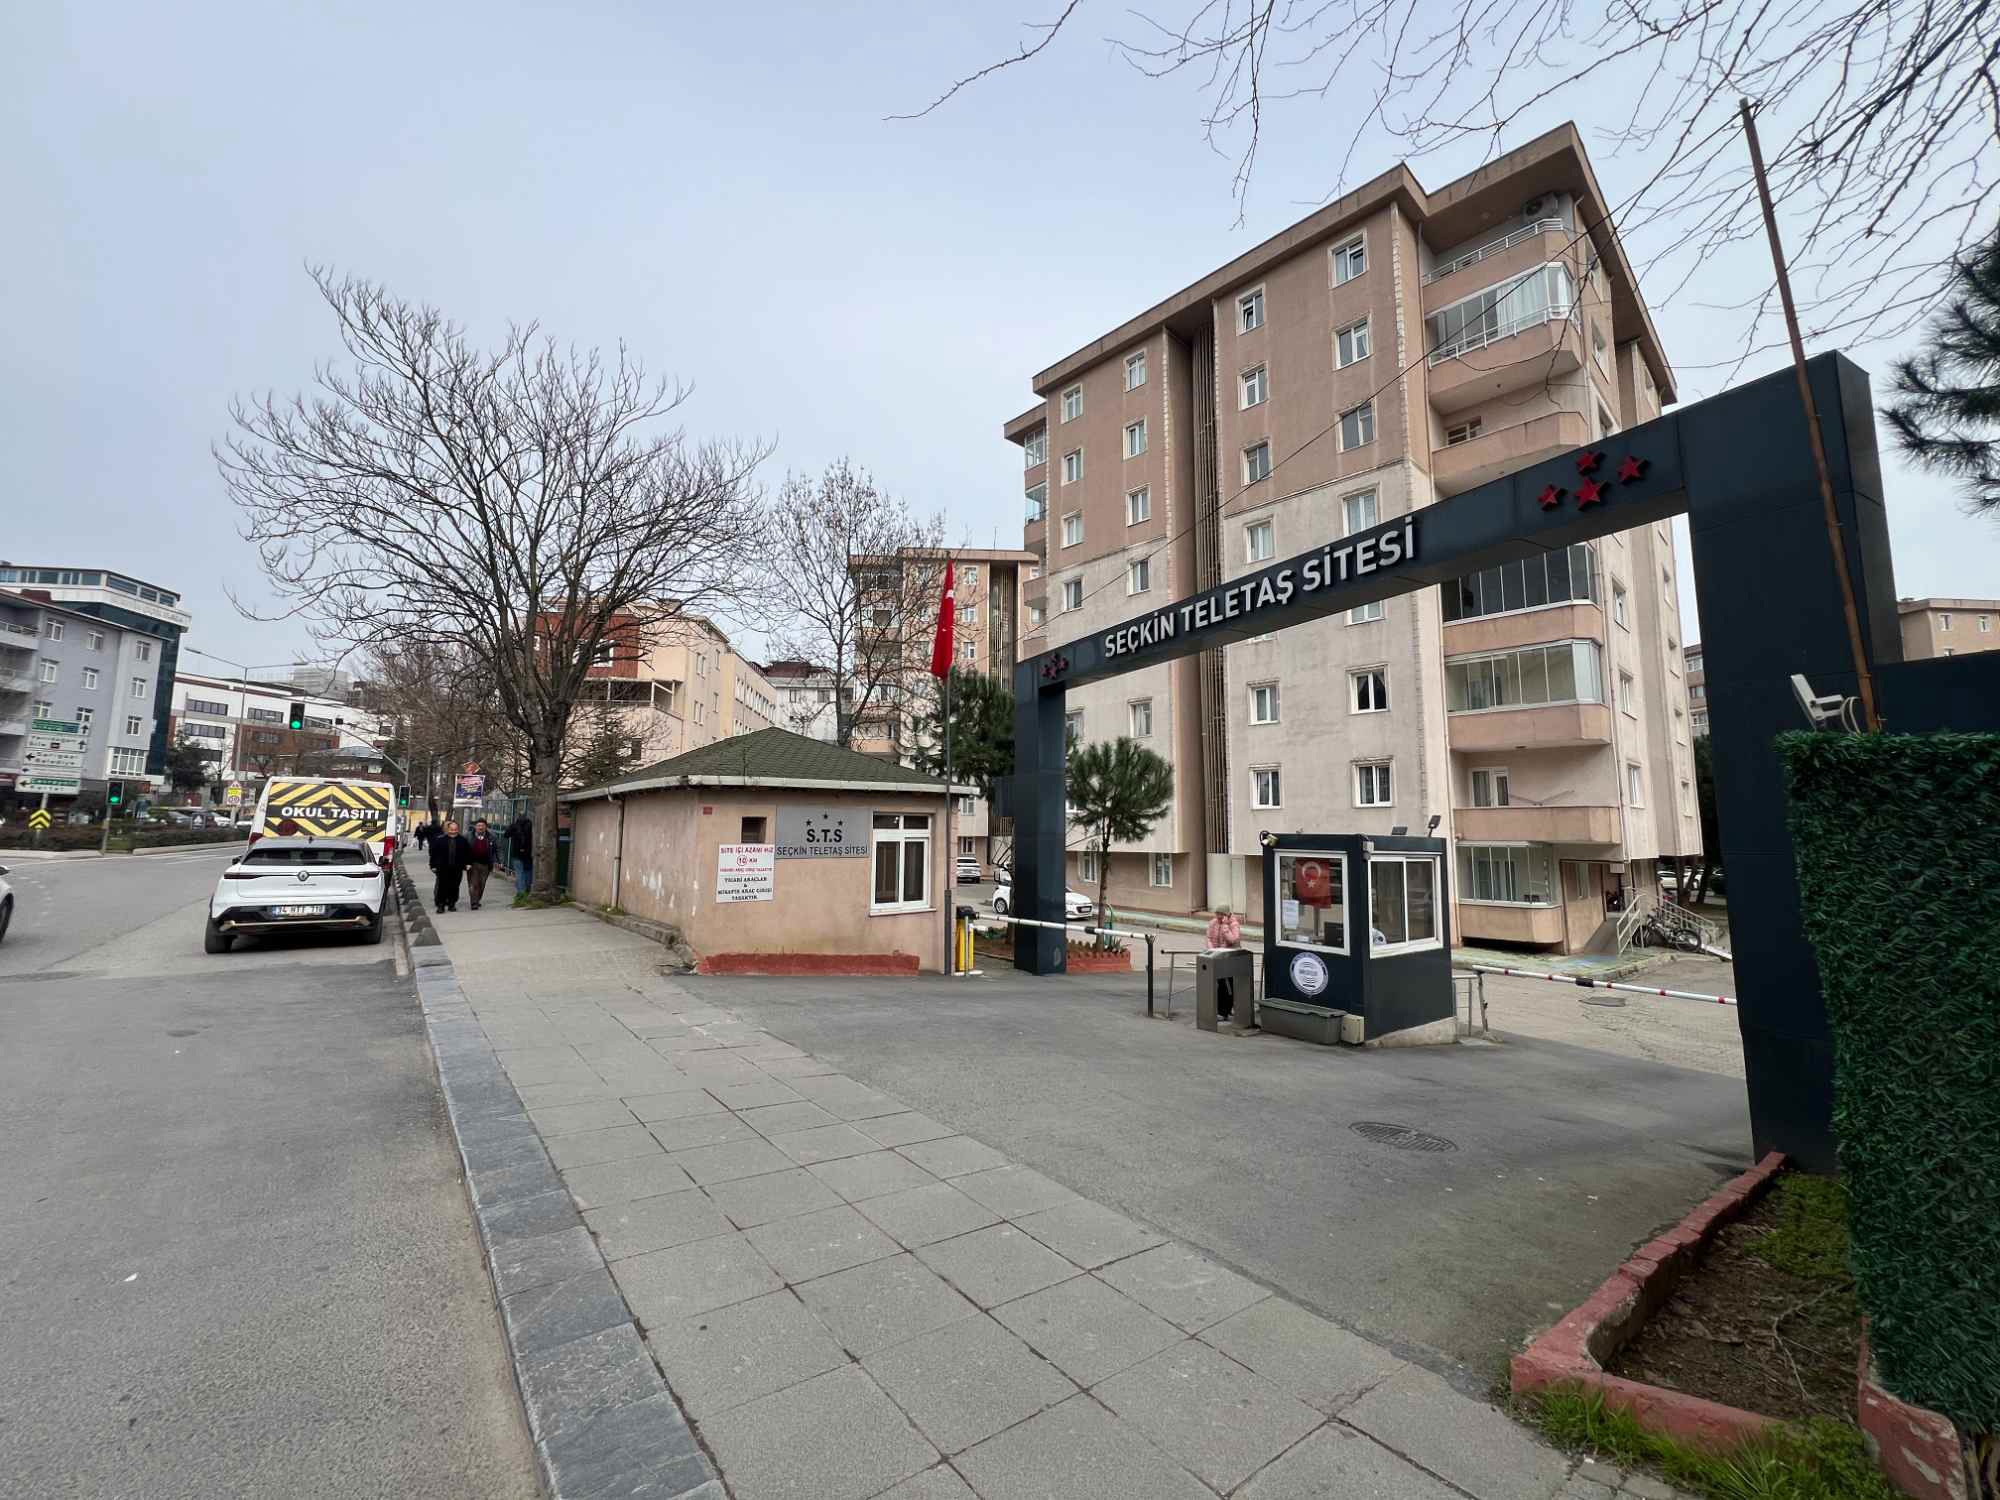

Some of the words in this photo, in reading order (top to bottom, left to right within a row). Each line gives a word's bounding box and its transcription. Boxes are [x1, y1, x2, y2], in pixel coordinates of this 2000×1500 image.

[1105, 611, 1175, 658] SEÇKİN
[1181, 569, 1294, 632] TELETAŞ
[1302, 515, 1414, 592] SİTESİ
[281, 807, 325, 817] OKUL
[806, 829, 842, 843] S.T.S
[776, 846, 808, 857] SEÇKİN
[809, 846, 843, 857] TELETAŞ
[844, 844, 868, 855] SİTESİ
